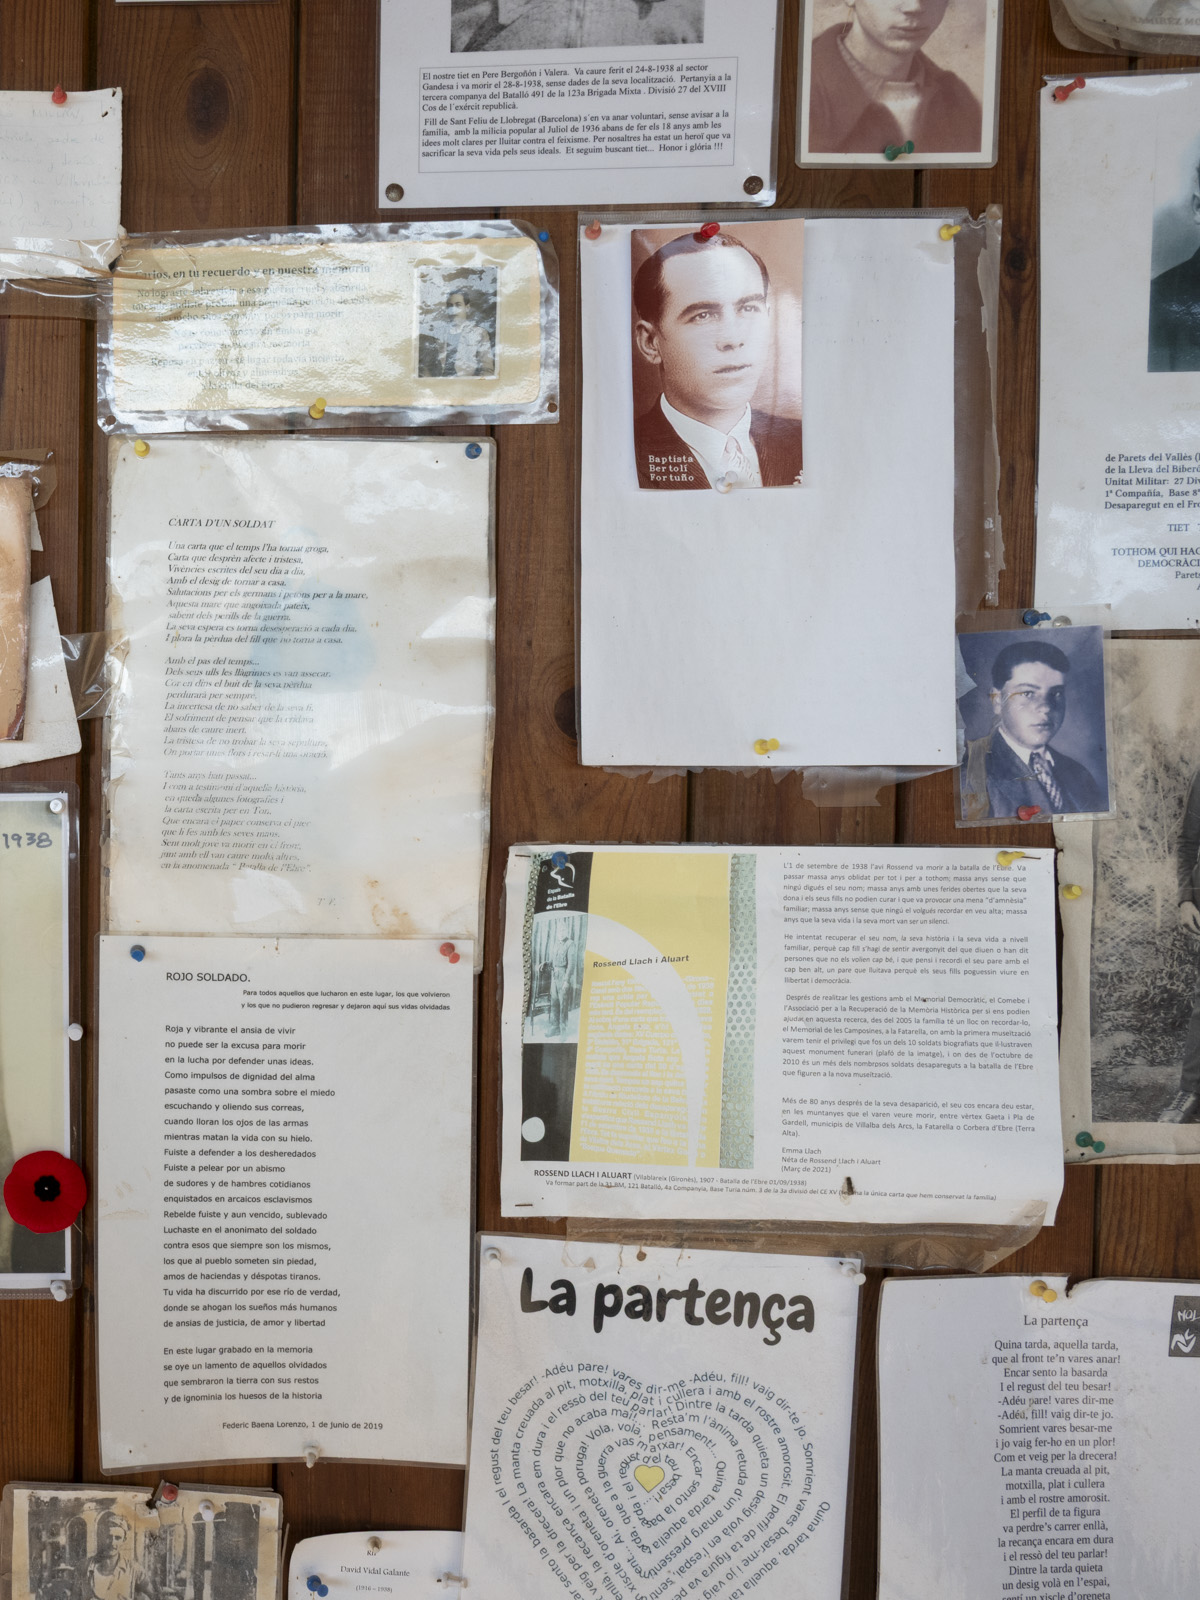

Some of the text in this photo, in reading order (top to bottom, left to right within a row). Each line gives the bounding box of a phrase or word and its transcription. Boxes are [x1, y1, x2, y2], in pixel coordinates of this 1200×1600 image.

[422, 104, 437, 112] Cos
[202, 267, 250, 278] recuerdo
[649, 455, 693, 463] Baptista
[1118, 454, 1146, 462] Parets
[1148, 453, 1163, 462] del
[1165, 452, 1193, 461] Vallès
[650, 473, 694, 482] Fortuño
[1105, 501, 1161, 512] Desaparegut
[168, 518, 202, 527] CARTA
[234, 519, 276, 528] SOLDAT
[1167, 524, 1190, 532] TIET
[1111, 547, 1178, 558] TOTHOM QUI
[593, 959, 627, 968] Rossend
[629, 957, 653, 966] Llach
[660, 955, 689, 964] Aluart
[166, 972, 251, 983] ROJO SOLDADO.
[165, 1025, 184, 1034] Roja
[194, 1026, 228, 1034] vibrante
[230, 1026, 238, 1034] el
[264, 1027, 275, 1035] de
[534, 1169, 570, 1177] ROSSEND
[572, 1170, 594, 1178] LLACH
[601, 1172, 632, 1180] ALUART
[520, 1267, 815, 1346] La partença
[1024, 1315, 1089, 1329] La partença
[994, 1340, 1119, 1352] Quina tarda, aquella tarda,
[578, 1363, 608, 1374] pare!
[612, 1369, 642, 1390] vares
[646, 1380, 686, 1394] dir-me
[251, 1421, 275, 1429] Baena
[276, 1421, 309, 1429] Lorenzo,
[329, 1421, 350, 1430] junio
[363, 1422, 383, 1430] 2019
[340, 1565, 410, 1577] David Vidal Galante
